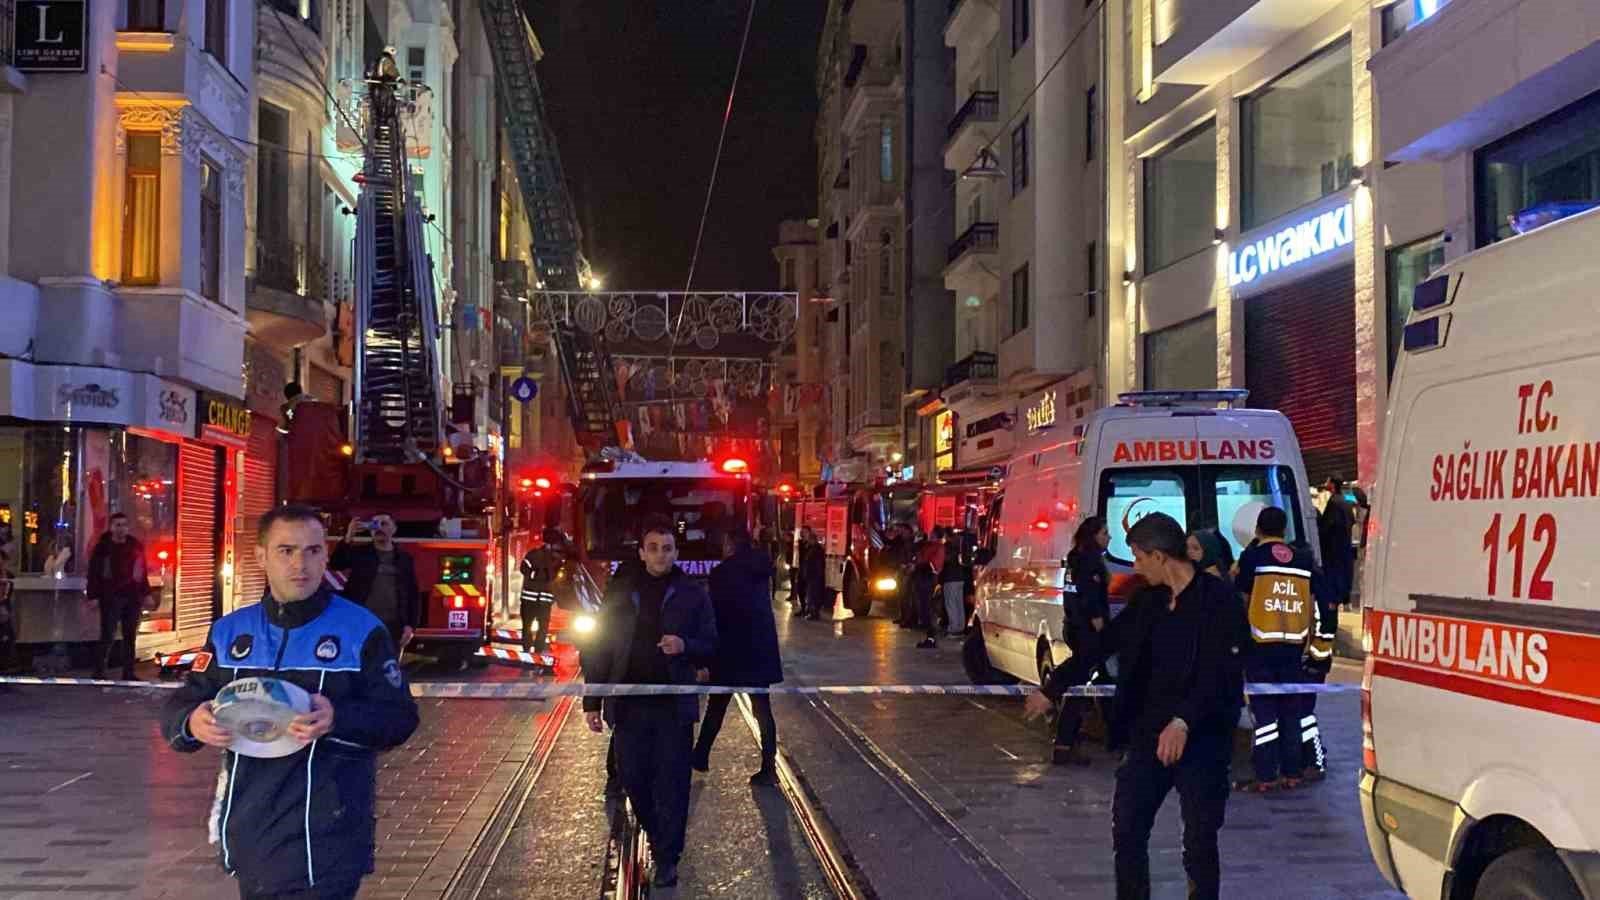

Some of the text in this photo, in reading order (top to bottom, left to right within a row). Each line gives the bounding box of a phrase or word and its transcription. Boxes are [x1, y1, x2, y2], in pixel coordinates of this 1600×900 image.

[35, 5, 63, 43] L
[1518, 380, 1558, 434] T.C.
[1113, 440, 1276, 463] AMBULANS
[1430, 441, 1508, 501] SAĞLIK
[1483, 512, 1558, 602] 112
[1378, 614, 1550, 686] AMBULANS
